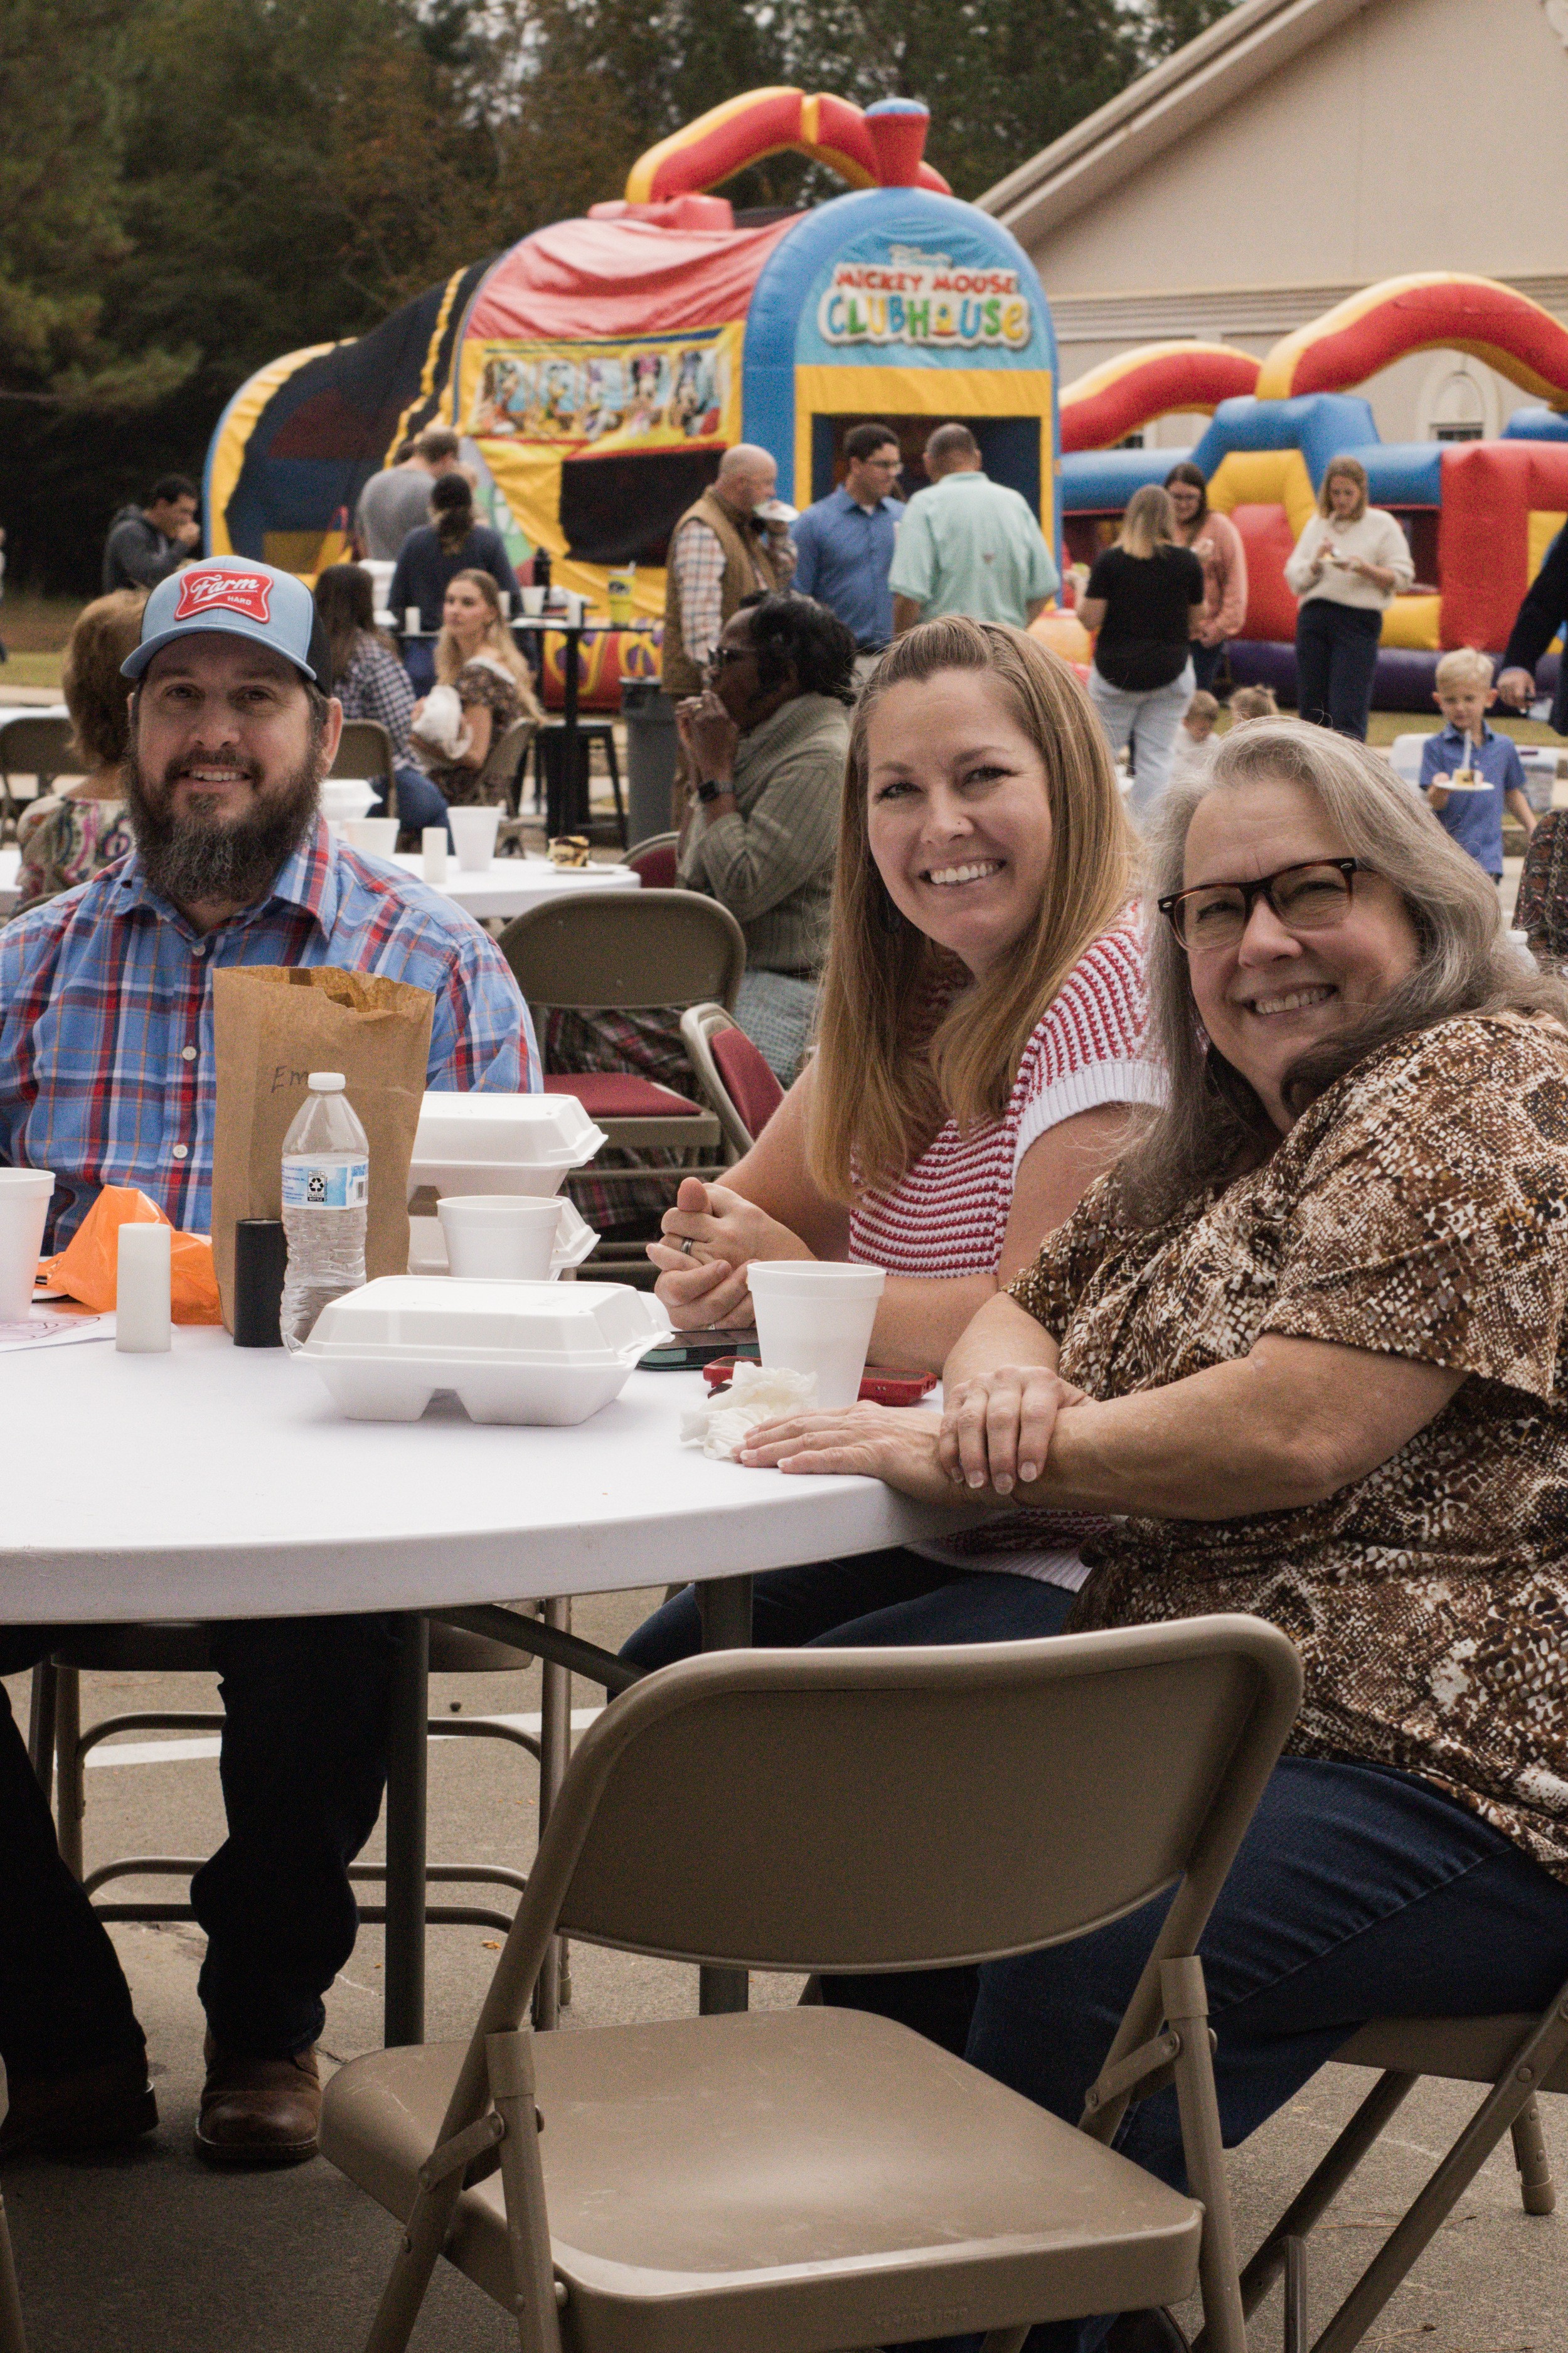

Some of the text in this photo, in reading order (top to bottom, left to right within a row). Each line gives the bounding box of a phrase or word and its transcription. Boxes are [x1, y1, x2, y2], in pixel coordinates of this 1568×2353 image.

[836, 269, 1017, 294] MICKEY MOUSE
[189, 574, 260, 601] Farm
[227, 595, 252, 606] HARD
